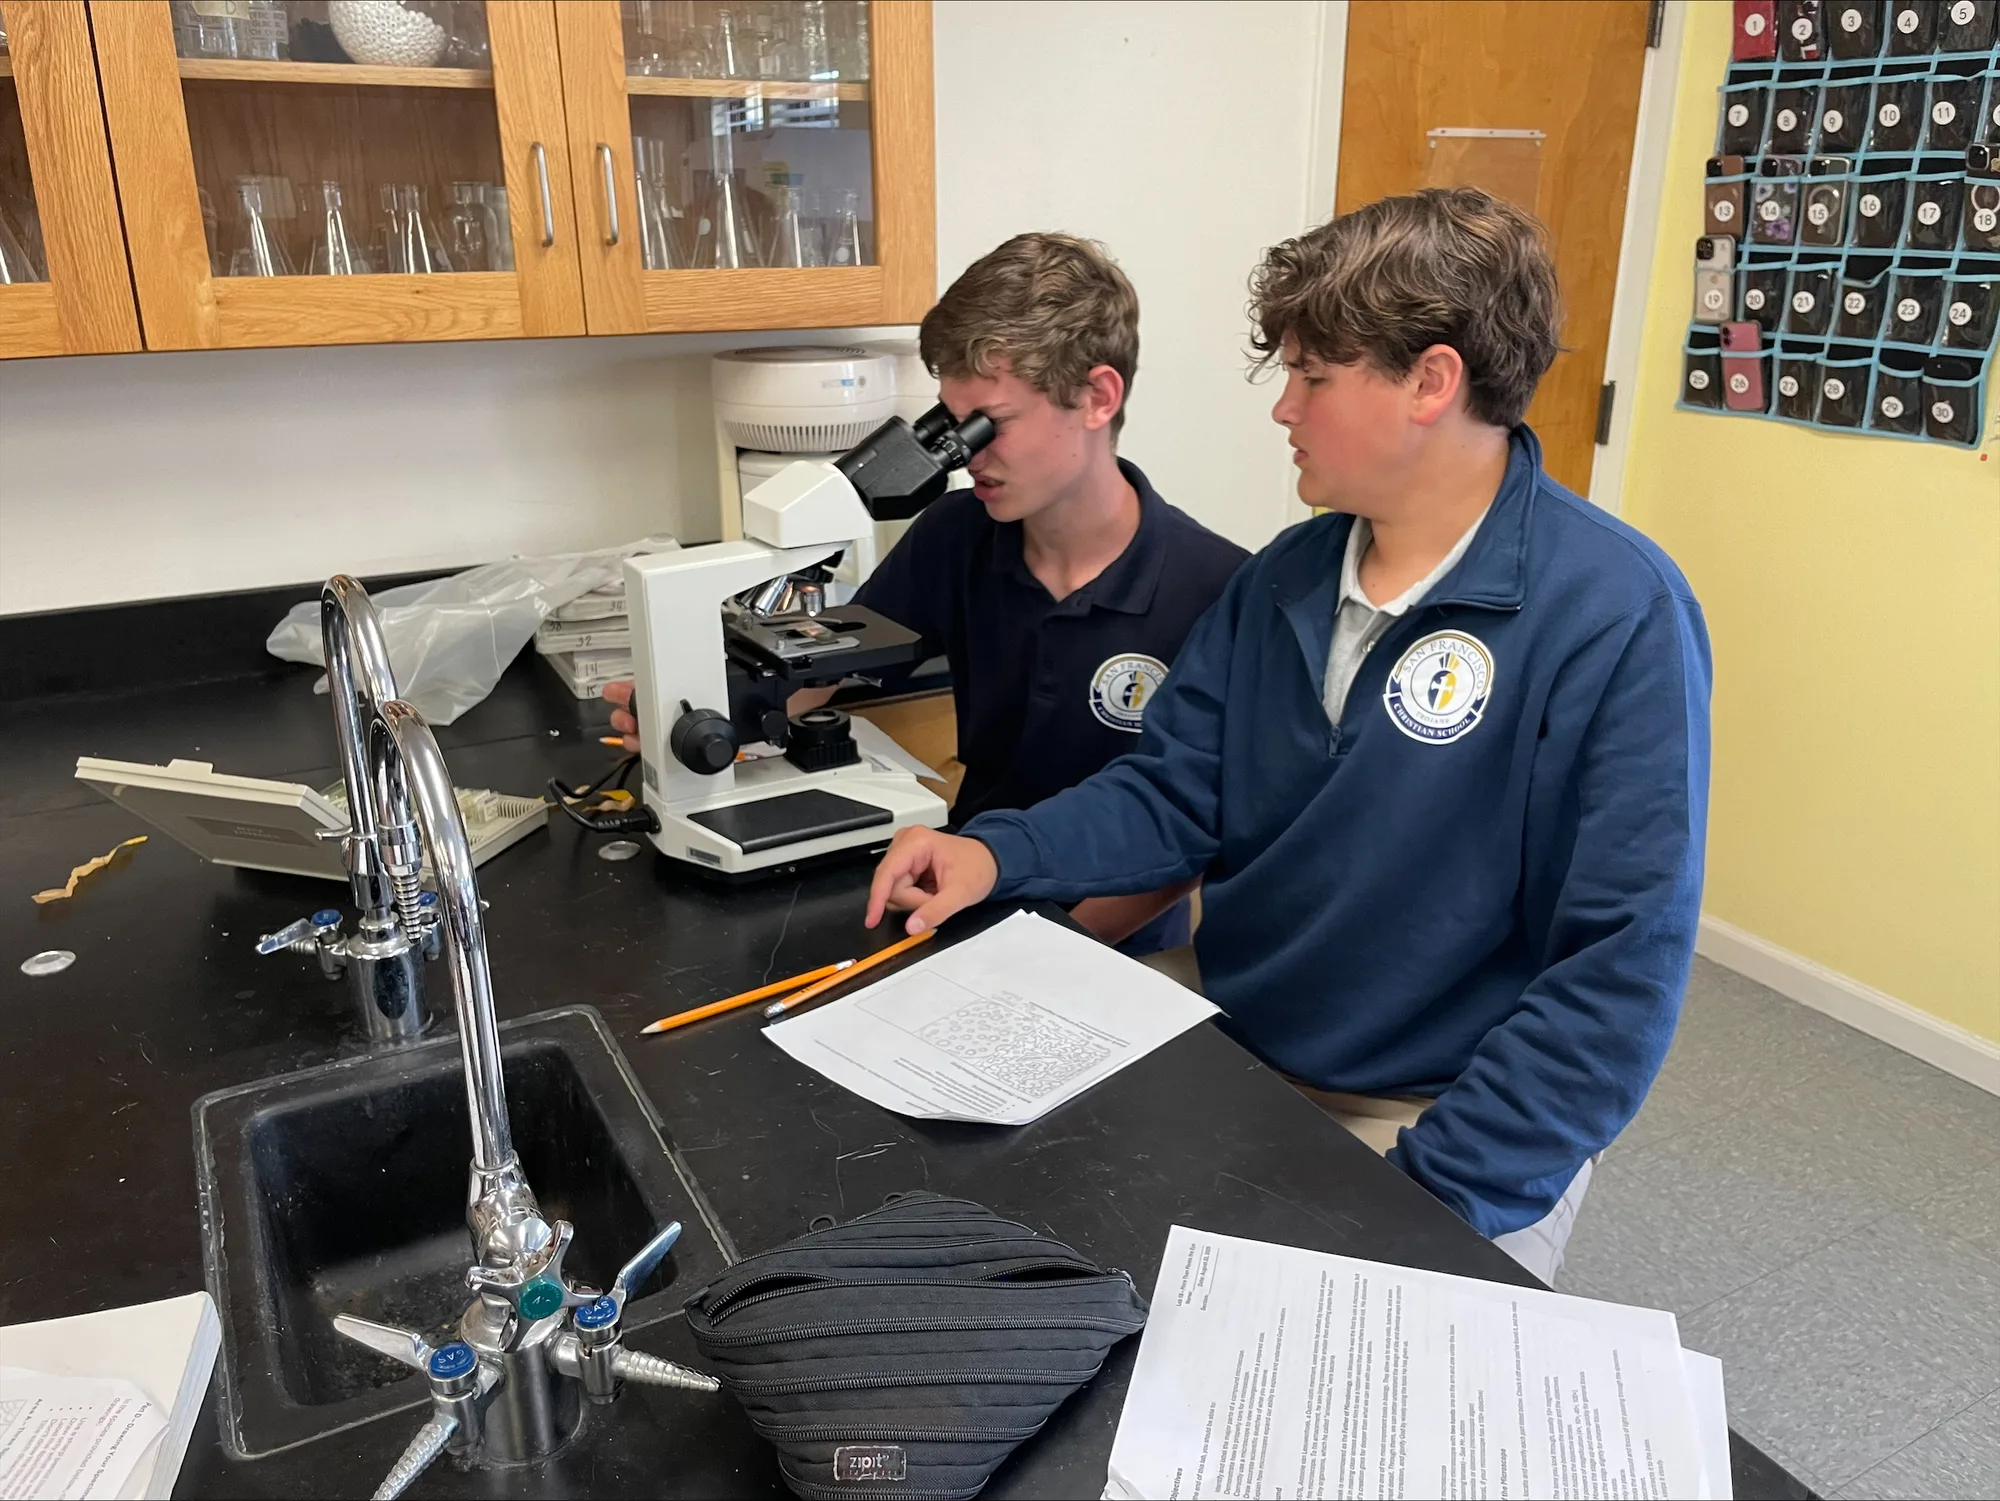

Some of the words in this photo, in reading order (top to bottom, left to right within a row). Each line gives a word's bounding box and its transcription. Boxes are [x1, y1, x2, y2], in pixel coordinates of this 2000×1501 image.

[1884, 110, 1896, 121] 10
[1938, 107, 1949, 118] 11
[1864, 200, 1876, 211] 16
[1812, 208, 1825, 219] 15
[1923, 208, 1936, 218] 17
[1979, 214, 1992, 225] 18
[1796, 296, 1809, 308] 21
[1848, 297, 1860, 309] 22
[1901, 304, 1915, 315] 23
[1952, 308, 1966, 319] 24
[1885, 401, 1898, 412] 29
[576, 635, 592, 648] 32
[1403, 648, 1426, 673] SAN
[1430, 640, 1486, 690] FRANCISCO
[586, 685, 597, 697] 15
[1394, 703, 1434, 737] CHRISTIAN
[1436, 718, 1471, 737] SCHOOL
[110, 1423, 134, 1451] Drawing
[101, 1450, 116, 1468] Your
[1170, 1468, 1183, 1500] Objectives
